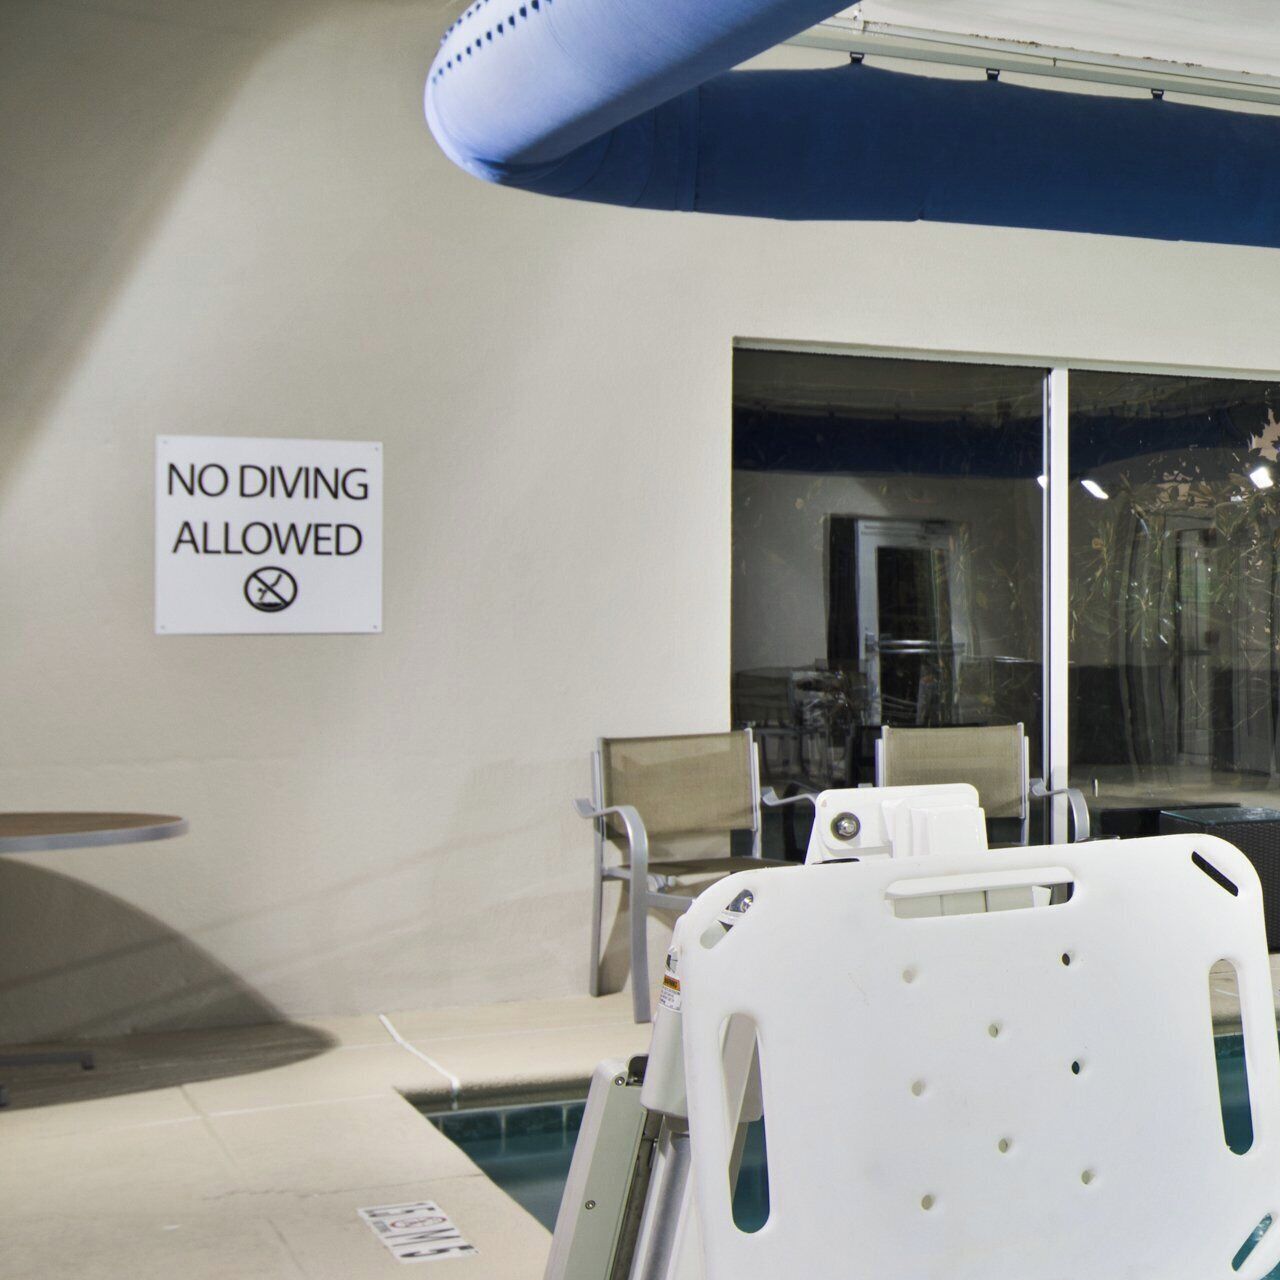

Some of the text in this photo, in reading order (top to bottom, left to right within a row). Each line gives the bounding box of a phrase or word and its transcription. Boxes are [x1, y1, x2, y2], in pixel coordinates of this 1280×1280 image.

[168, 463, 369, 500] NO DIVING
[172, 520, 364, 556] ALLOWED
